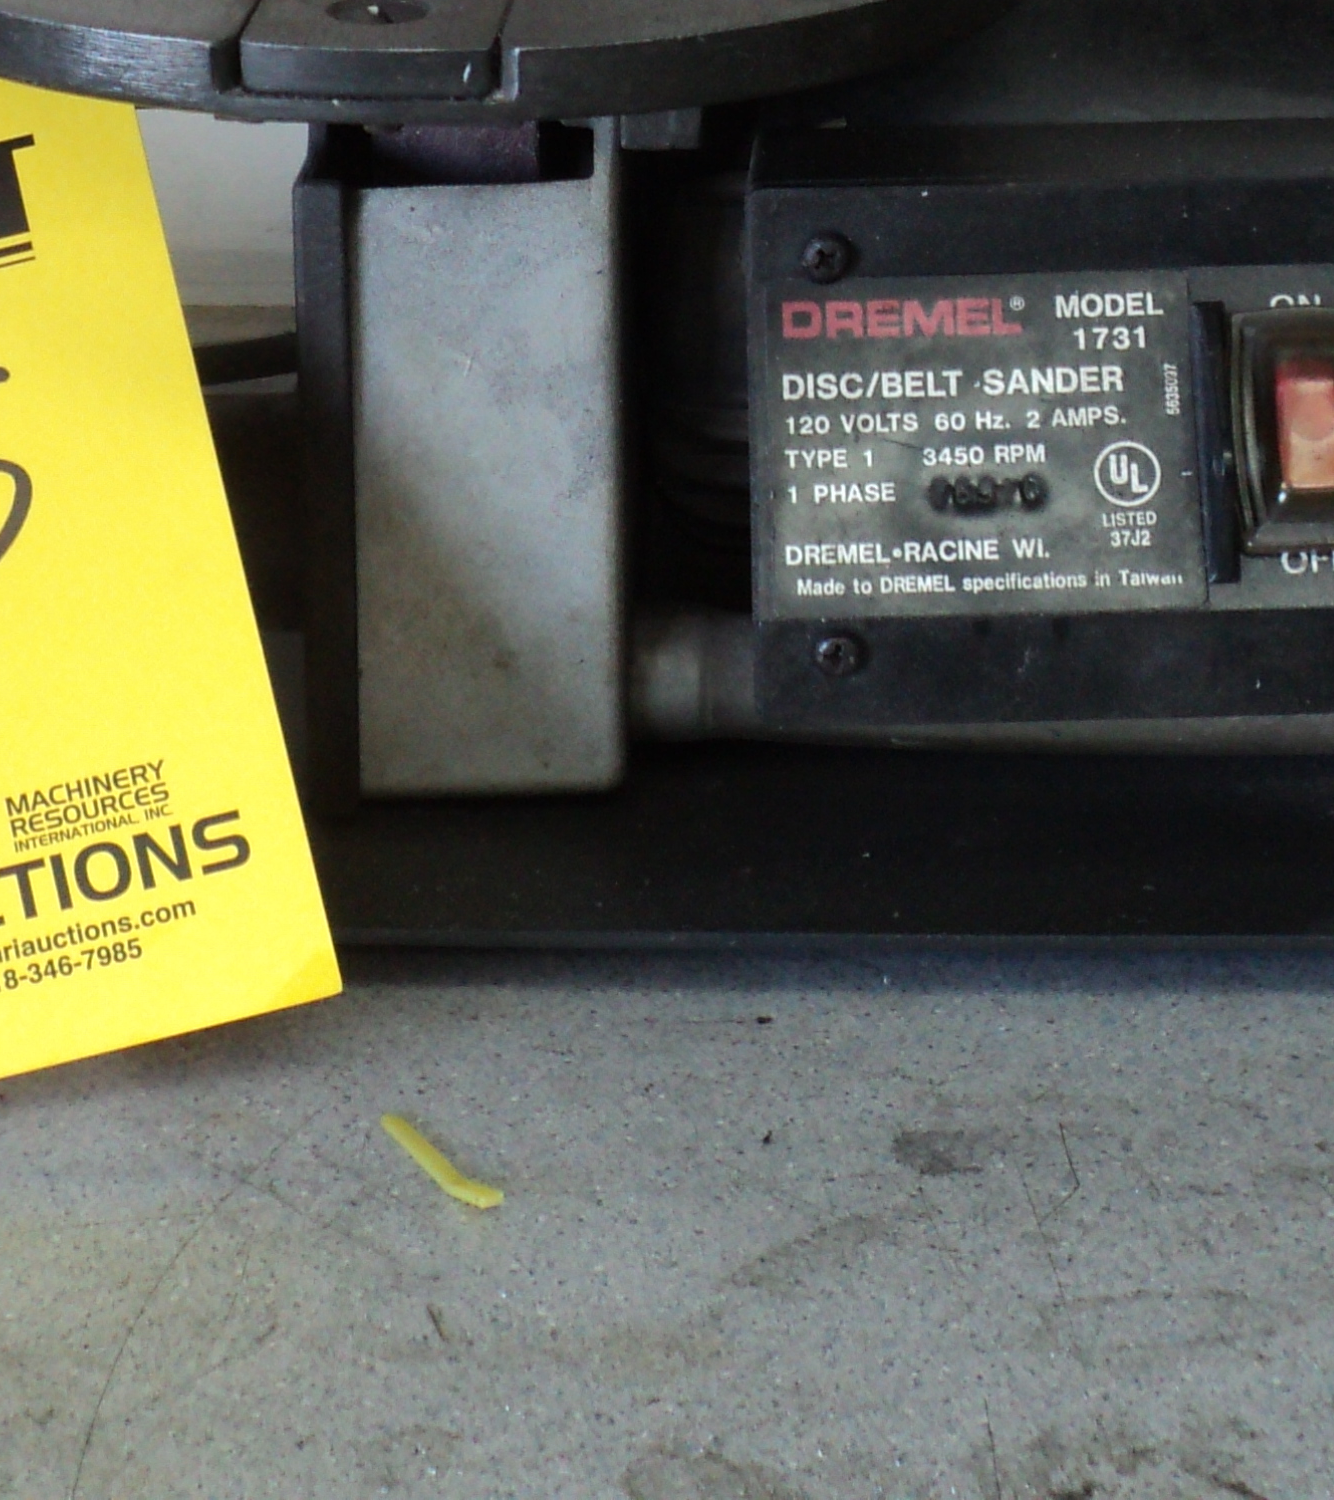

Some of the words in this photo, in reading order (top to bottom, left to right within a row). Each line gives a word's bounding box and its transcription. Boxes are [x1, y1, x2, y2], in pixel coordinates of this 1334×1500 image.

[1054, 291, 1165, 319] MODEL
[1072, 326, 1147, 351] 1731
[782, 369, 964, 401] DISC/BELT
[982, 365, 1125, 396] SANDER
[785, 415, 831, 436] 120
[840, 412, 919, 434] VOLTS
[934, 412, 966, 432] 60
[975, 411, 1012, 431] Hz.
[1027, 410, 1041, 429] 2
[1051, 405, 1127, 427] AMPS.
[785, 449, 848, 469] TYPE
[863, 449, 874, 468] 1
[922, 446, 985, 467] 3450
[994, 444, 1046, 465] RPM
[1108, 453, 1149, 494] UL
[787, 486, 798, 504] 1
[813, 483, 897, 503] PHASE
[1102, 510, 1158, 528] LISTED
[1012, 538, 1051, 559] WI.
[1110, 530, 1152, 548] 37J2
[797, 577, 846, 597] Made
[853, 578, 873, 595] to
[880, 575, 956, 594] DREMEL
[962, 571, 1088, 592] specifications
[1095, 570, 1111, 587] in
[4, 759, 167, 818] MACHINERY
[10, 782, 170, 839] RESOURCES
